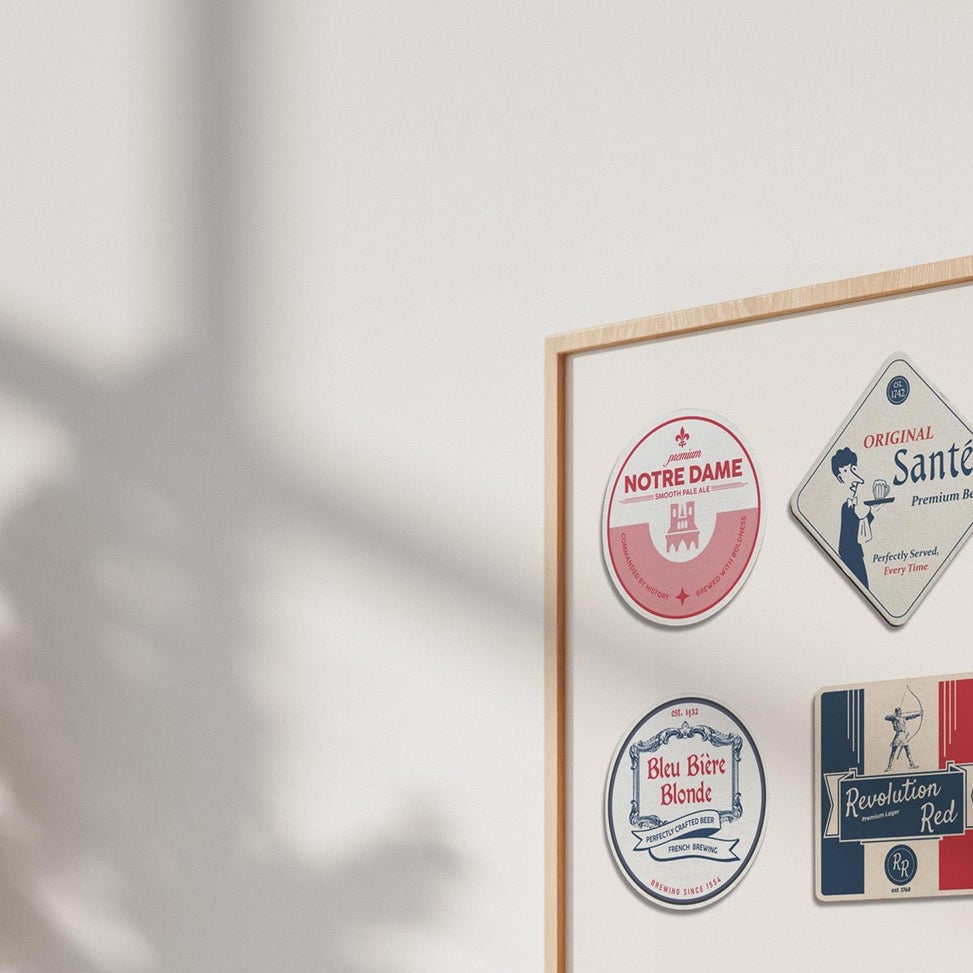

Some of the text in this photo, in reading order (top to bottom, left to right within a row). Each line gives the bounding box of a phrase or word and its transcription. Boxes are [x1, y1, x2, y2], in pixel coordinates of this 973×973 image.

[863, 426, 933, 449] ORIGINAL
[893, 439, 973, 486] Santé
[624, 458, 742, 493] NOTRE DAME
[655, 486, 710, 500] SMOOTH PALE ALE
[911, 490, 959, 506] Premium
[621, 533, 669, 599] COMMANDED BY HISTORY
[696, 515, 747, 597] BREWED WITH BOLDNESS
[872, 546, 939, 563] Perfectly Served,
[884, 562, 928, 576] Every Time
[647, 753, 725, 780] Bleu Bière
[660, 781, 712, 805] Blonde
[846, 778, 942, 818] Revolution
[862, 813, 884, 822] Premium
[921, 799, 958, 833] Red
[646, 828, 674, 843] PERFECTLY
[675, 819, 699, 833] CRAFTED
[668, 843, 718, 854] FRENCH BREWING
[650, 879, 680, 895] BREWING
[684, 886, 703, 895] SINCE
